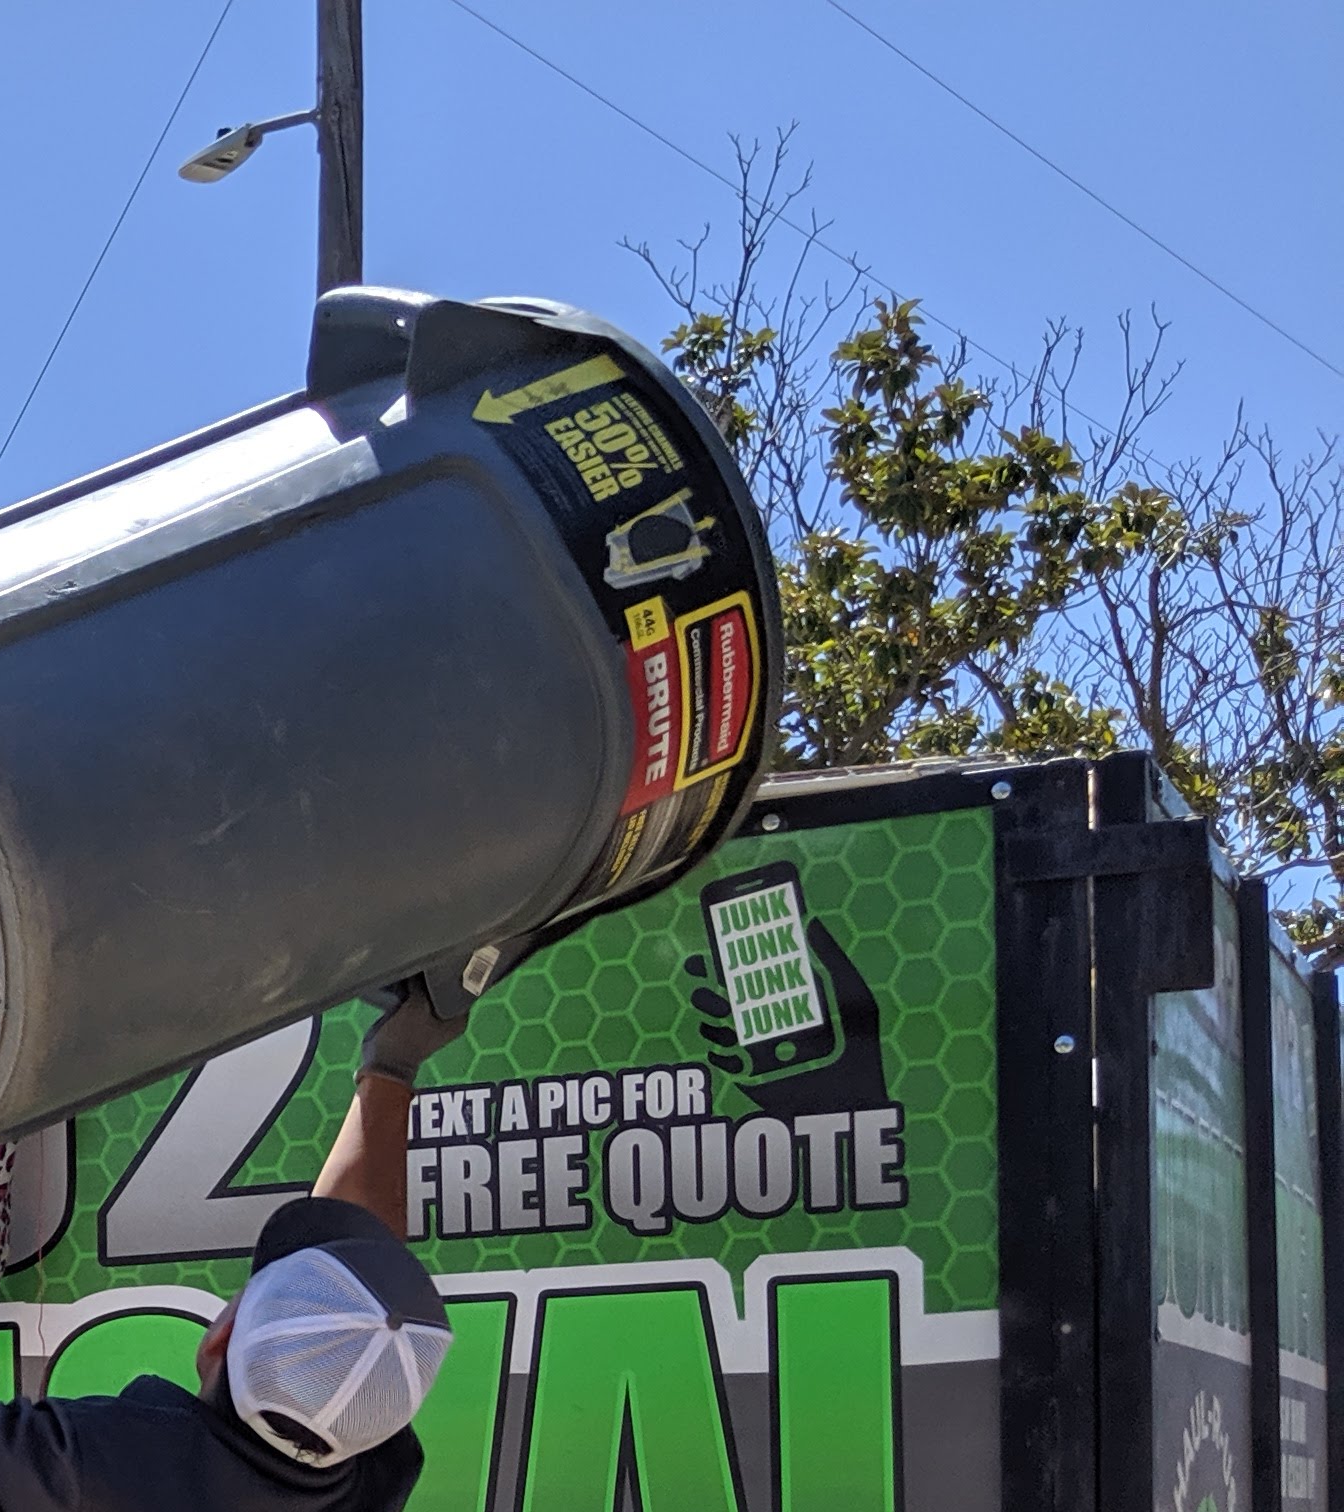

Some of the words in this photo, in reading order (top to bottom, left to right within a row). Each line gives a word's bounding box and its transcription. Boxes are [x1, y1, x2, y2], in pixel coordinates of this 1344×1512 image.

[544, 417, 620, 502] EASIER
[574, 401, 658, 489] 50%
[690, 628, 706, 715] Commercial
[717, 621, 736, 754] Rubbermaid
[644, 651, 671, 786] BRUTE
[689, 713, 705, 772] Products
[719, 888, 792, 936] JUNK
[725, 923, 800, 971] JUNK
[734, 957, 808, 1005] JUNK
[741, 992, 815, 1040] JUNK
[407, 1088, 491, 1140] TEXT
[500, 1084, 530, 1132] A
[538, 1076, 612, 1129] PIC
[622, 1068, 707, 1121] FOR
[407, 1135, 587, 1237] FREE
[609, 1109, 903, 1229] QUOTE
